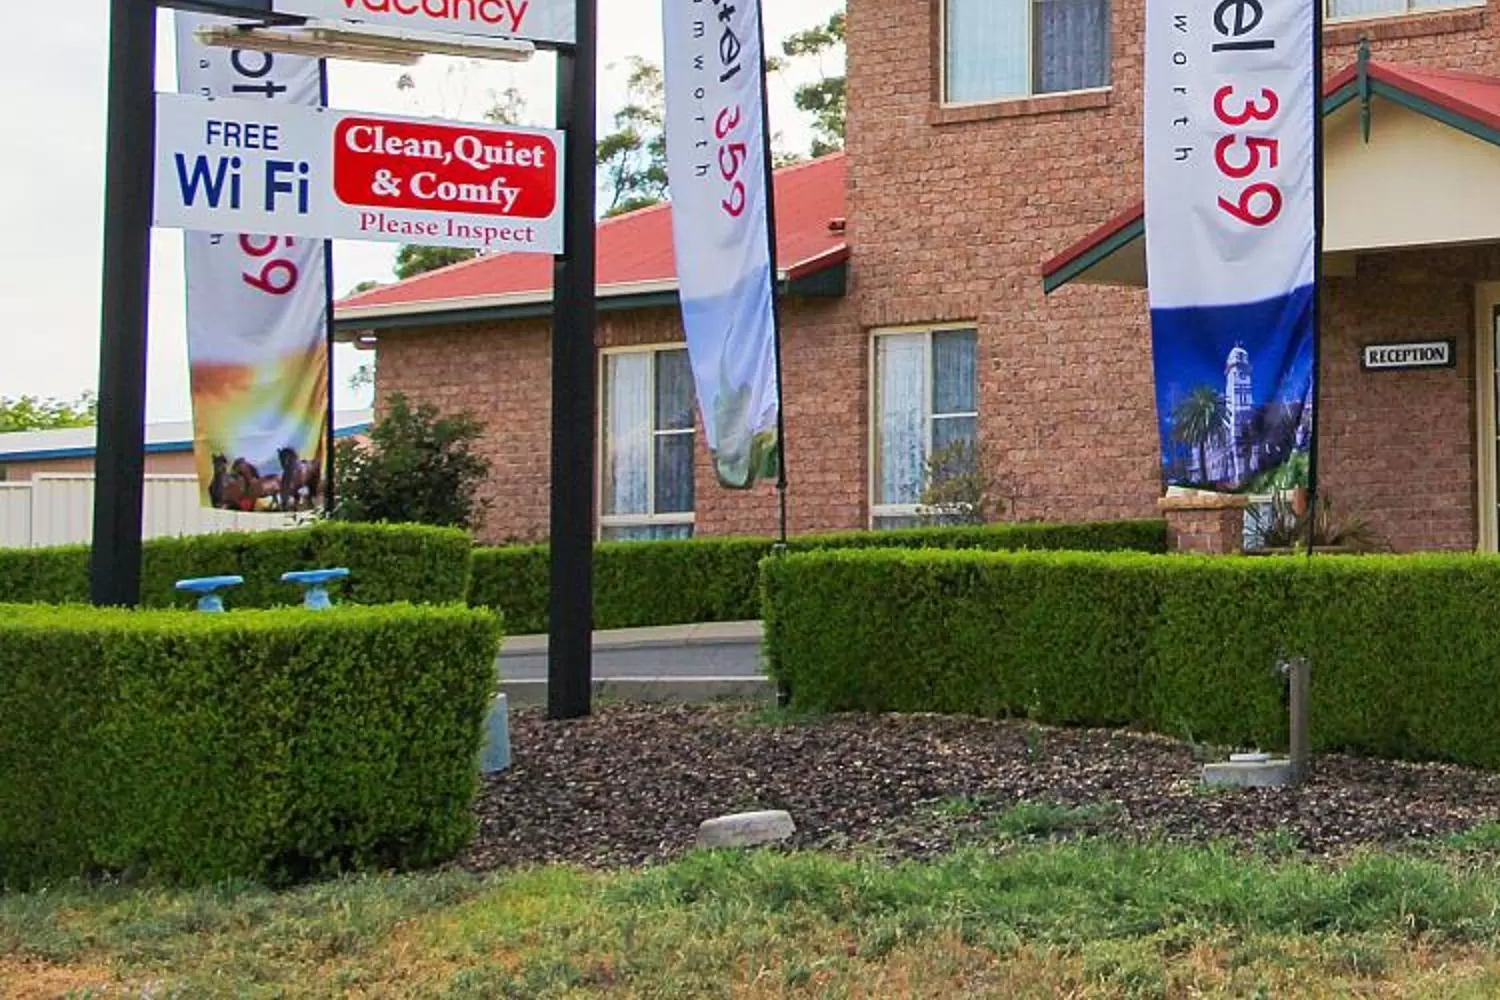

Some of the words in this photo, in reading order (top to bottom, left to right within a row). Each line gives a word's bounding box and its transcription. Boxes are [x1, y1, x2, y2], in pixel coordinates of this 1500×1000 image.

[206, 120, 278, 150] FREE
[1213, 85, 1283, 227] 359
[715, 104, 747, 217] 359
[174, 152, 242, 209] Wi
[265, 160, 309, 214] Fi
[371, 169, 402, 197] &
[410, 171, 524, 213] Comfy
[359, 211, 438, 236] Please
[447, 219, 536, 246] Inspect
[1369, 347, 1445, 364] RECEPTION
